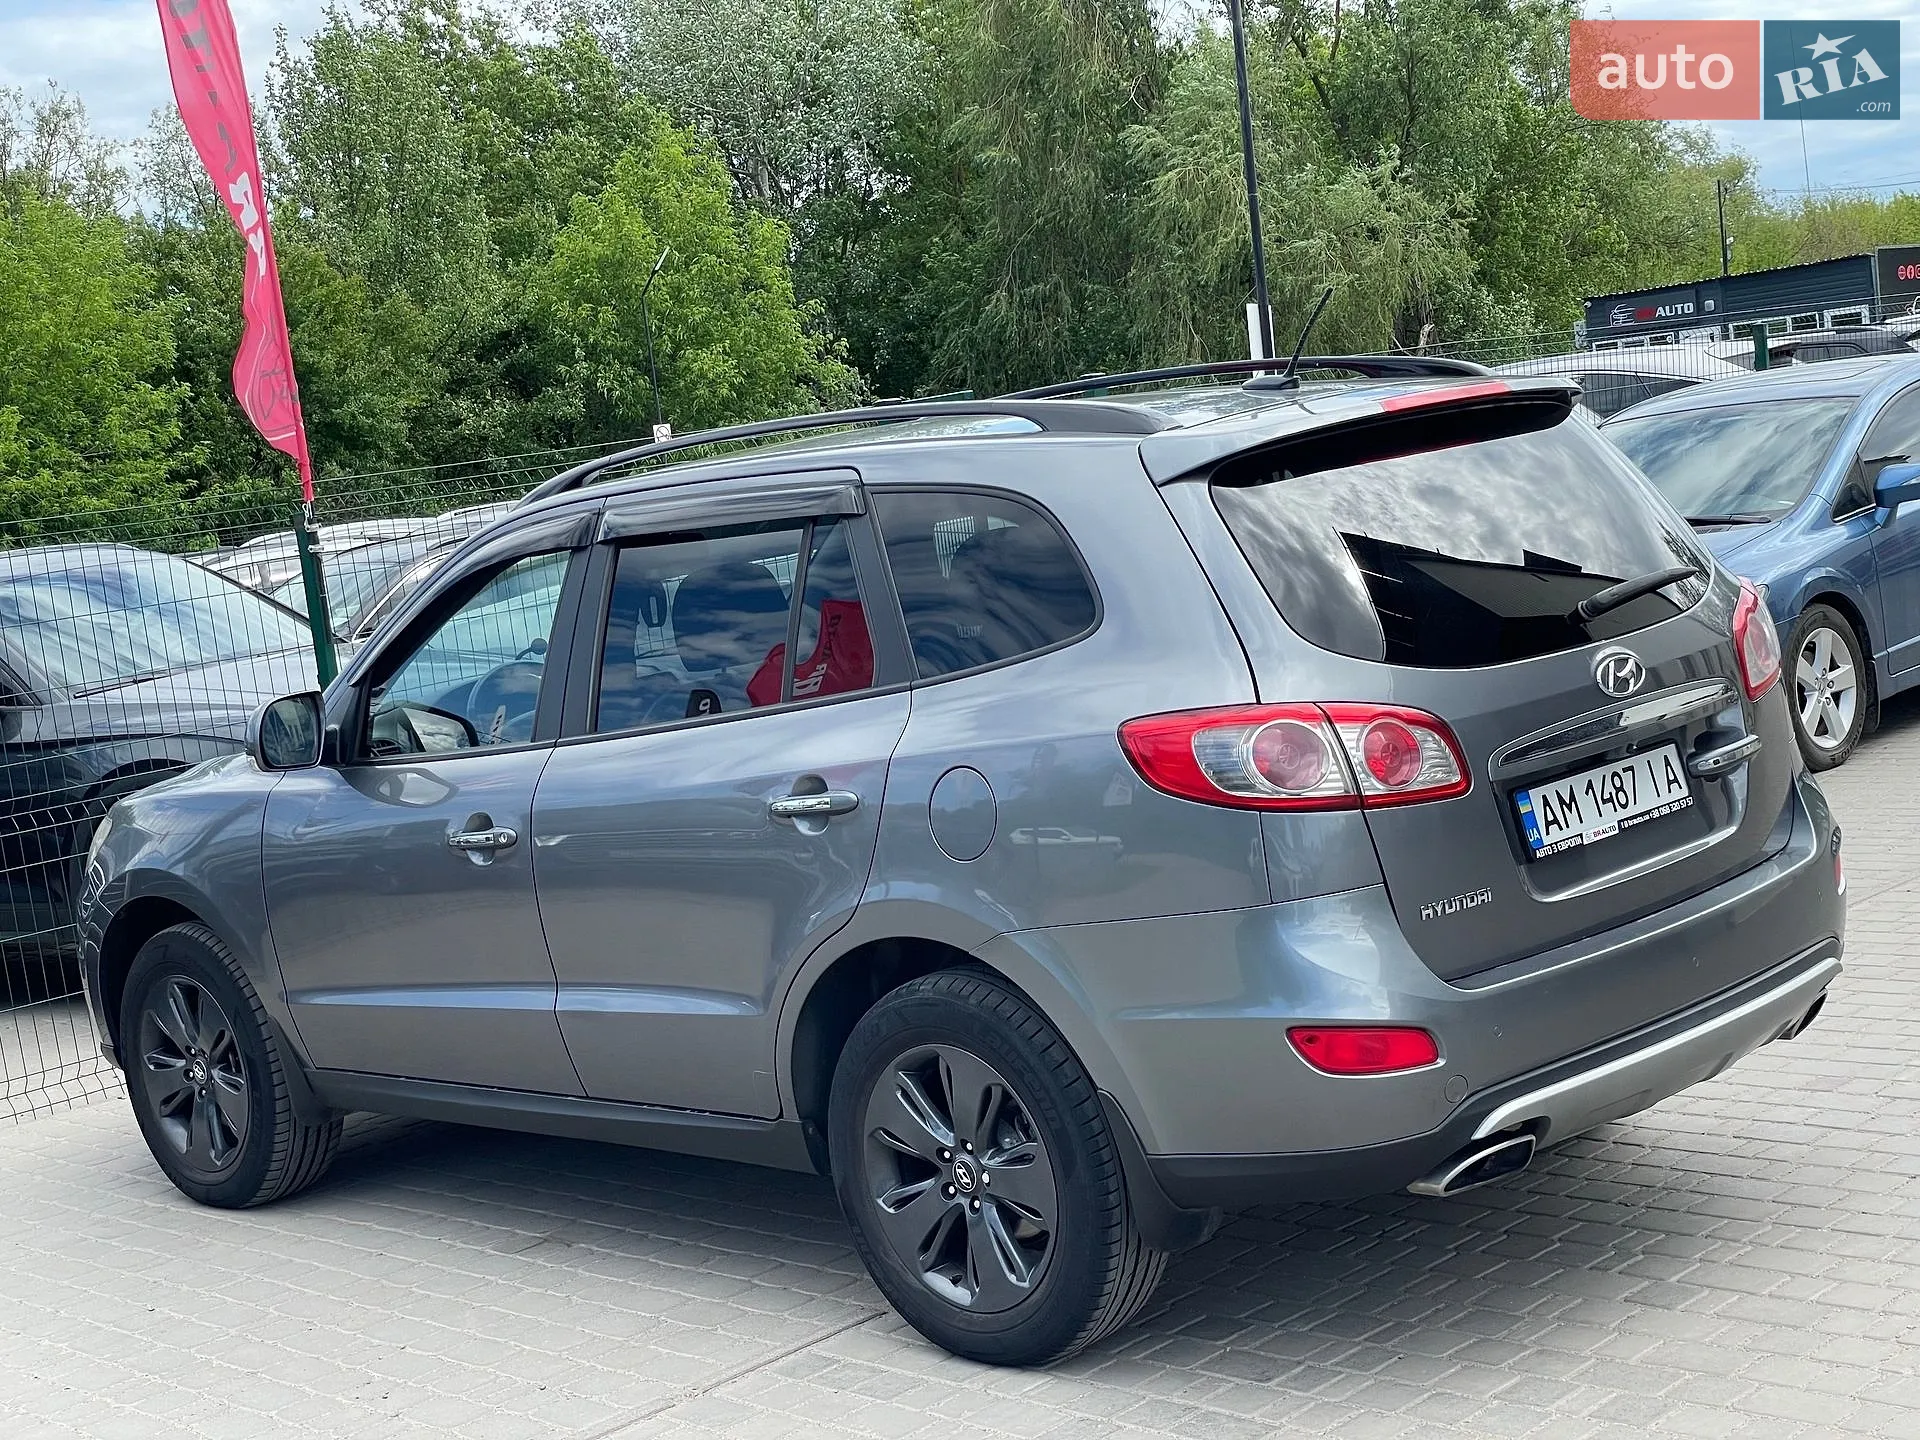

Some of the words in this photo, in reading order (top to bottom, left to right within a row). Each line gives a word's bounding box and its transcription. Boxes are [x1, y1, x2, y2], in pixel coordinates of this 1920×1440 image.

[1541, 785, 1584, 836] AM
[1585, 765, 1638, 818] 1487
[1646, 754, 1682, 798] IA
[1527, 827, 1541, 842] UA
[1420, 887, 1492, 921] HYUNDAI
